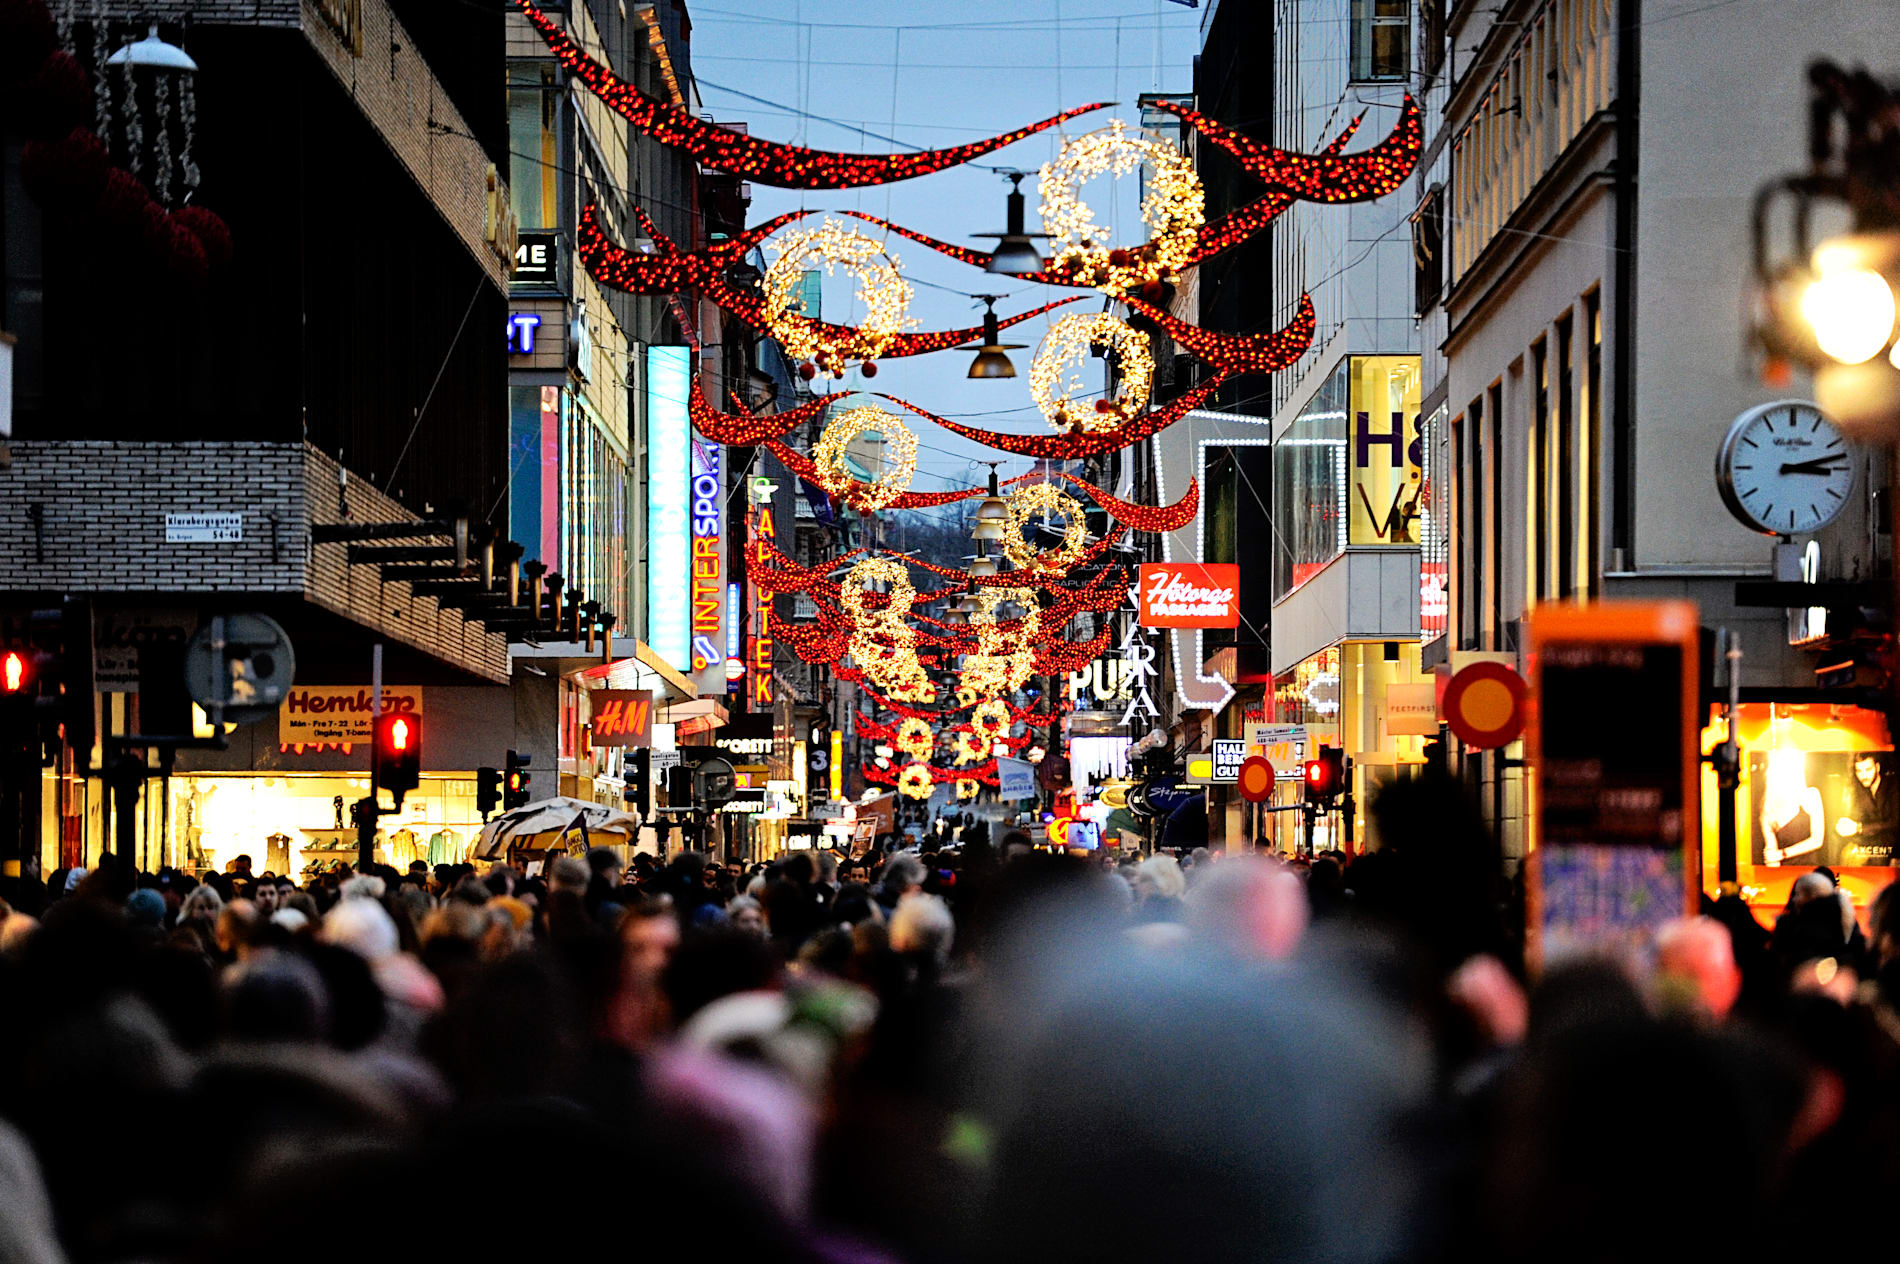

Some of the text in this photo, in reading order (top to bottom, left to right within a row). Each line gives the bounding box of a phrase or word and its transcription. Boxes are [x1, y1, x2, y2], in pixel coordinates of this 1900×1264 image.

[168, 516, 239, 528] Klarabergsgatan
[1146, 572, 1234, 604] Hötorgs
[1150, 603, 1229, 616] PASSAGEN
[288, 690, 415, 716] Hemköp
[290, 719, 306, 727] Mån
[595, 700, 650, 736] H&M
[346, 729, 373, 737] T-bane
[811, 750, 828, 770] 3
[1851, 846, 1893, 854] AXCENT
